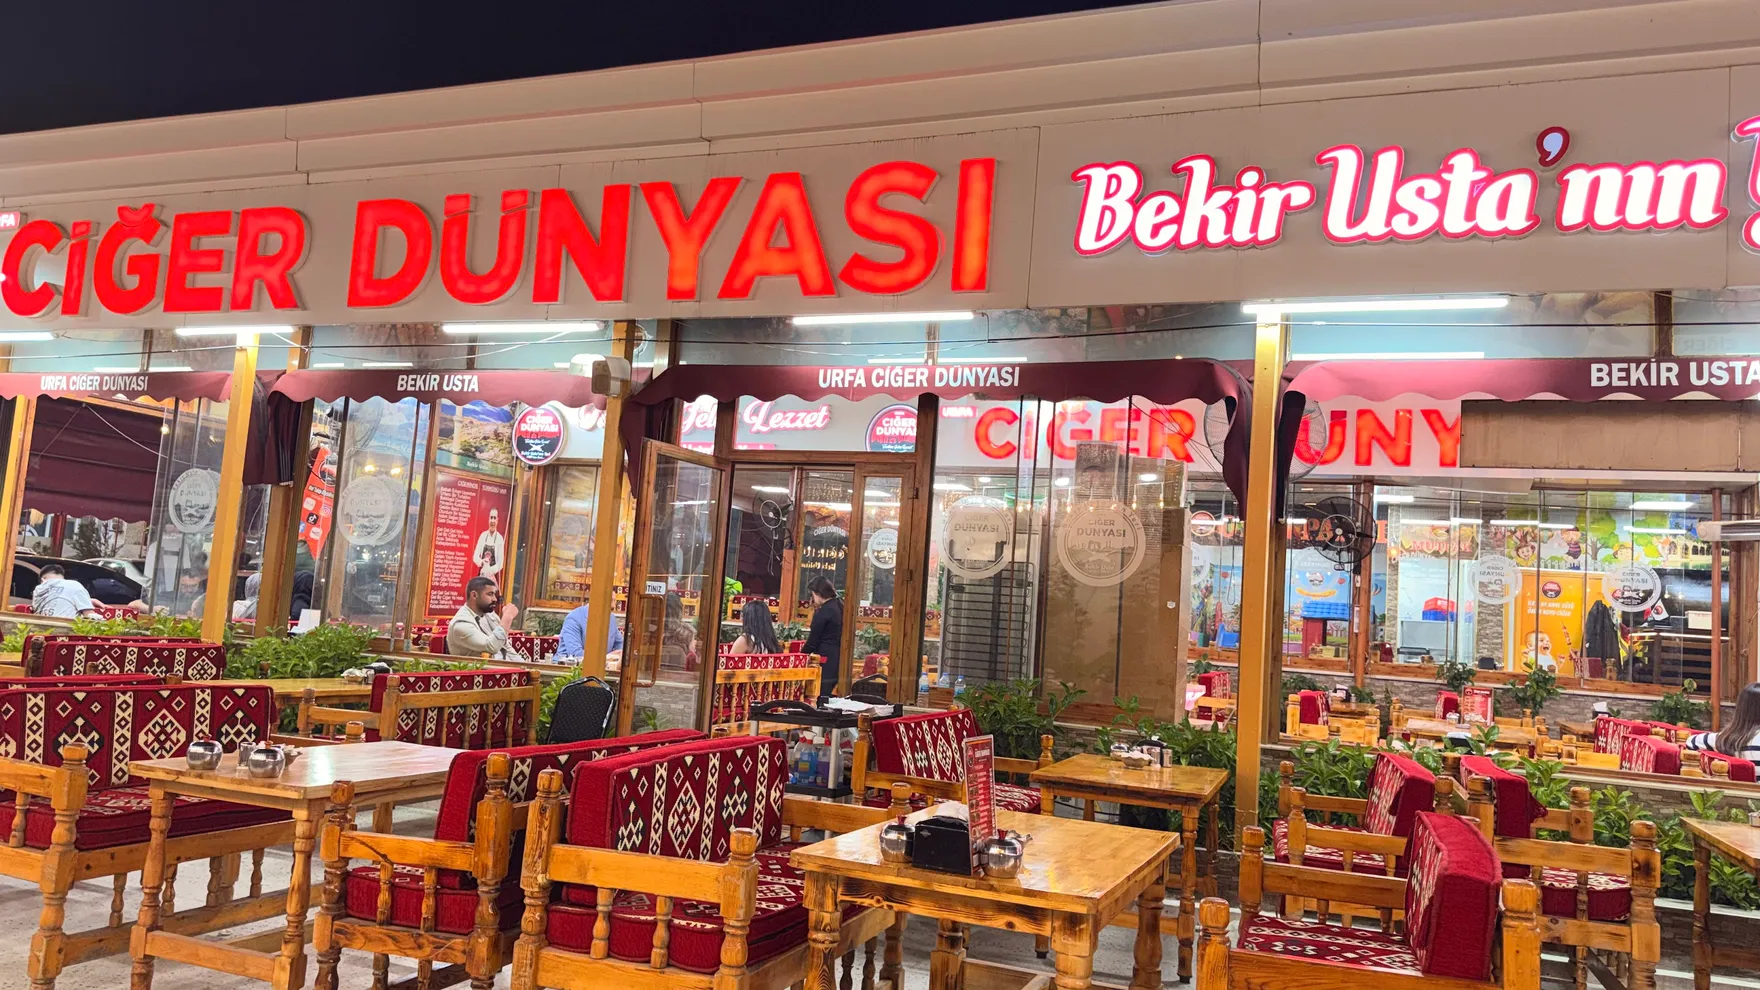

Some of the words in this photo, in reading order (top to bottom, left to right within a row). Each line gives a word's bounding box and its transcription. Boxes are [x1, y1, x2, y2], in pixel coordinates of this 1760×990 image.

[1072, 154, 1316, 256] Bekir
[1316, 126, 1729, 244] Usta'nın
[1, 203, 306, 316] CİĞER
[347, 158, 996, 307] DÜNYASI
[40, 375, 68, 391] URFA
[69, 373, 101, 391] CİĞER
[102, 373, 149, 392] DÜNYASI
[397, 372, 440, 393] BEKİR
[442, 374, 480, 393] USTA
[819, 368, 867, 389] URFA
[871, 365, 929, 389] CİĞER
[934, 364, 1020, 388] DÜNYASI
[1591, 358, 1679, 387] BEKİR
[1690, 361, 1760, 386] USTA
[743, 399, 830, 433] Lezzet
